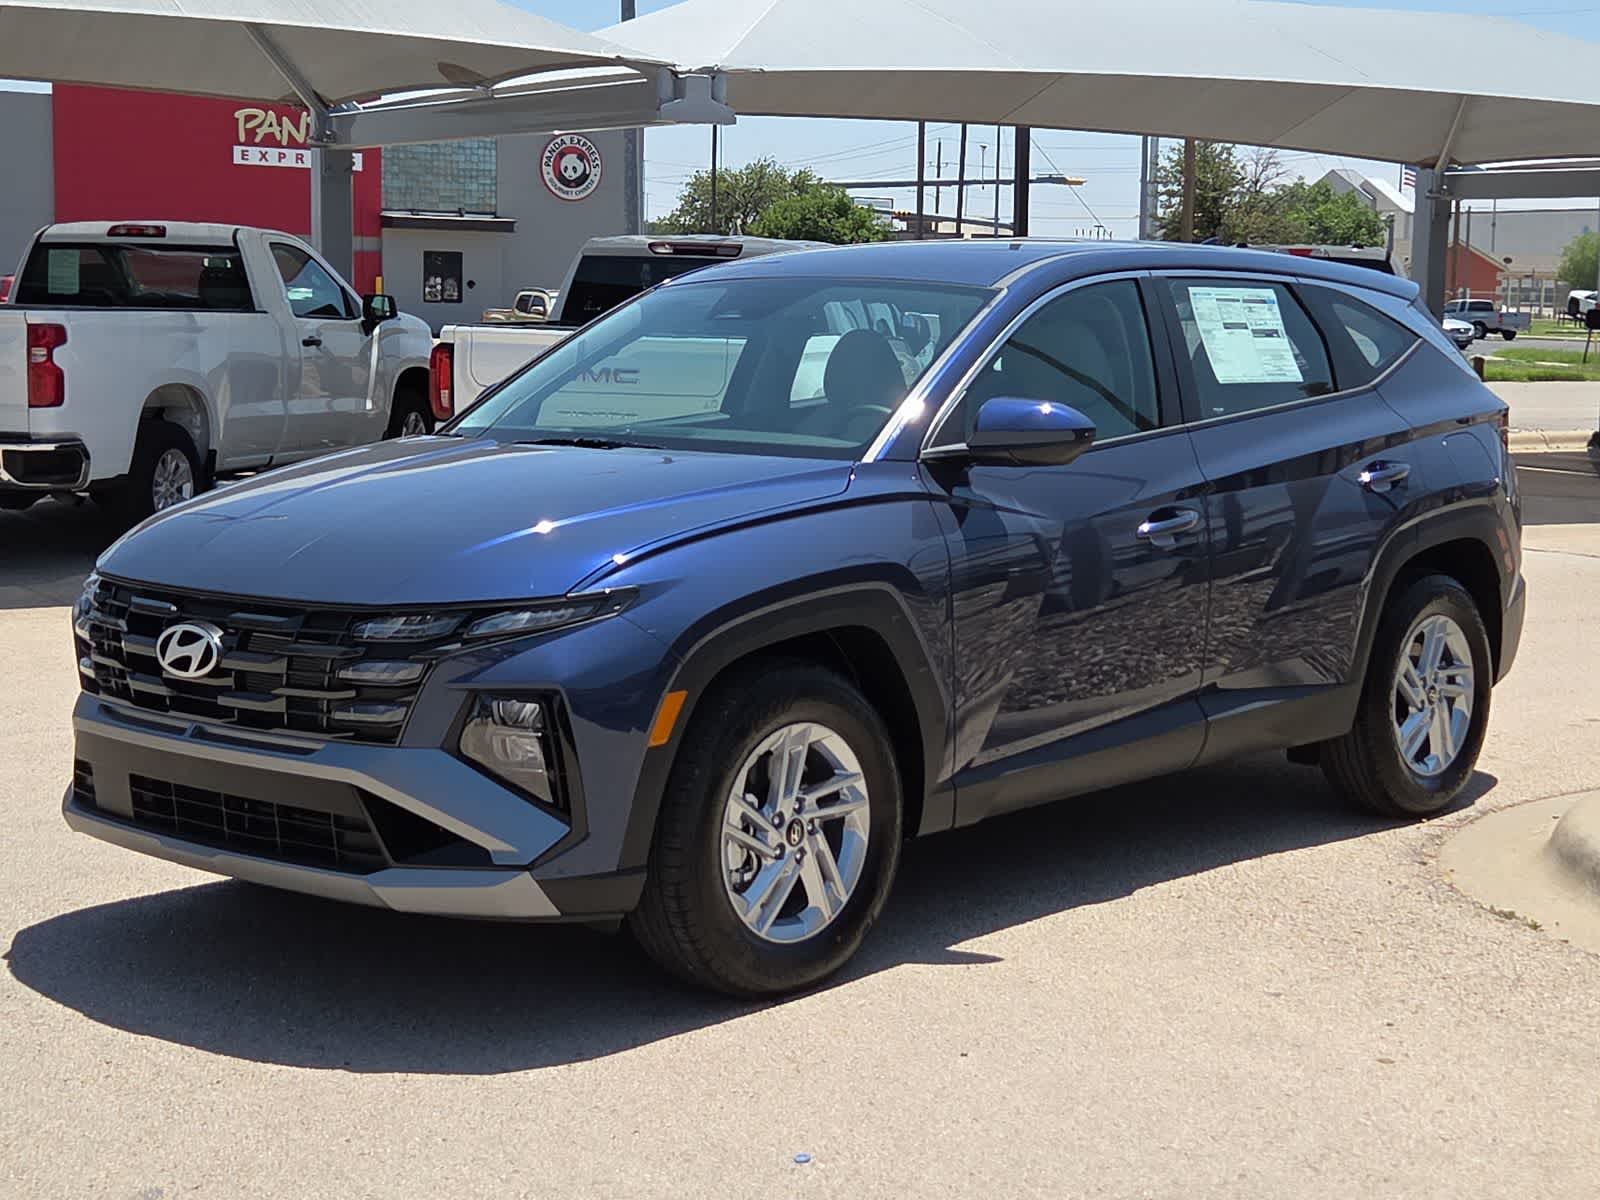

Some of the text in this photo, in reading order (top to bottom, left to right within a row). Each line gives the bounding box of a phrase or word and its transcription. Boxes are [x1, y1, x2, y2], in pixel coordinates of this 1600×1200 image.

[234, 108, 311, 146] PAN
[543, 136, 600, 169] PANDA EXPRESS
[578, 367, 641, 385] MC
